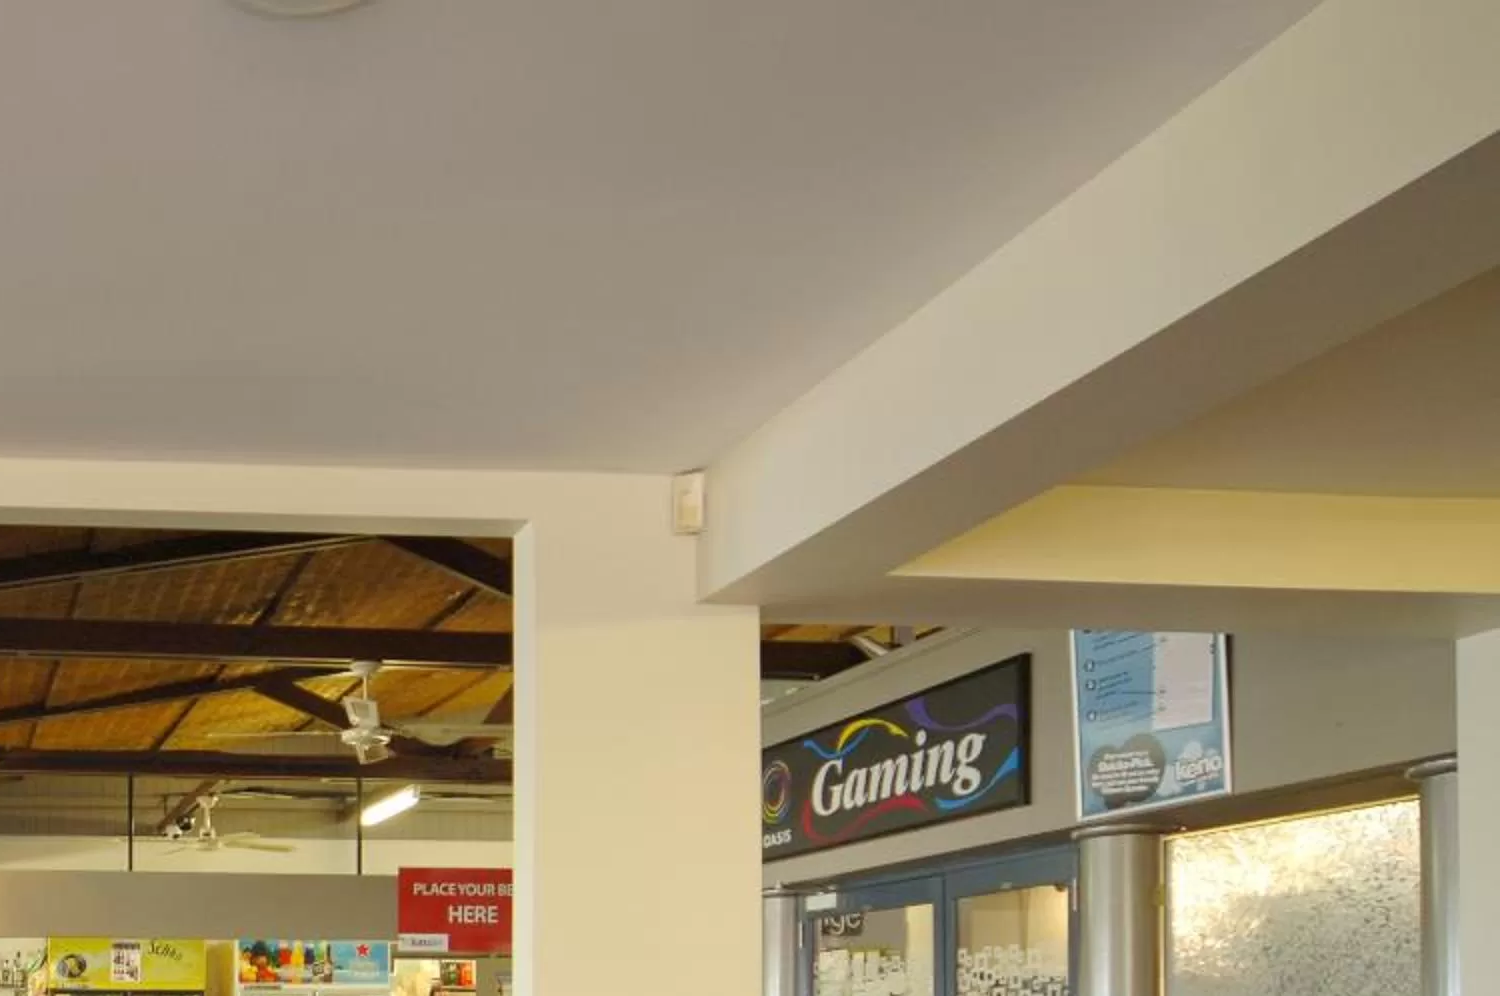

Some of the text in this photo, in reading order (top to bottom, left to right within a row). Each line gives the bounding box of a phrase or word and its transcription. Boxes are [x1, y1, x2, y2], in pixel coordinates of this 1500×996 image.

[812, 728, 987, 817] Gaming
[413, 883, 457, 896] PLACE
[457, 883, 495, 896] YOUR
[448, 905, 499, 924] HERE
